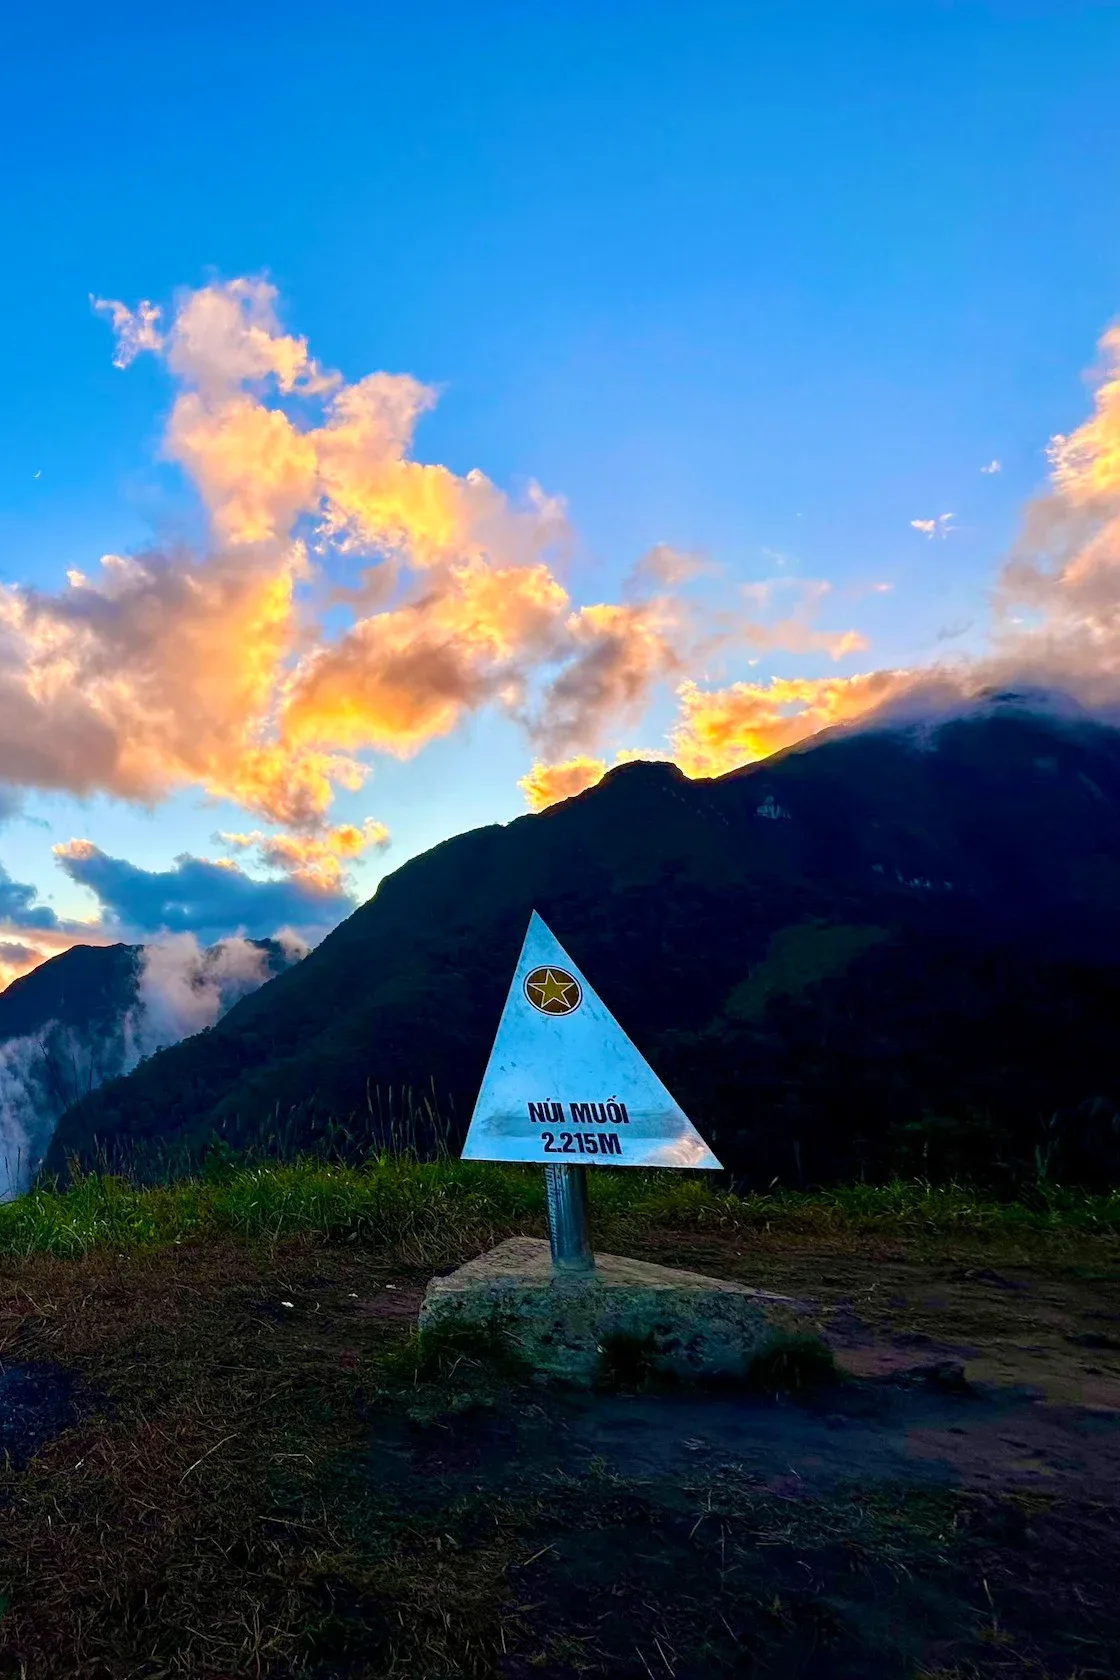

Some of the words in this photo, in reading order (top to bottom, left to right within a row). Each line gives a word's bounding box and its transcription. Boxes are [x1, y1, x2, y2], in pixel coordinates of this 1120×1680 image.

[527, 1097, 565, 1123] NÚI
[569, 1095, 630, 1124] MUỐI
[541, 1131, 623, 1155] 2.215M
